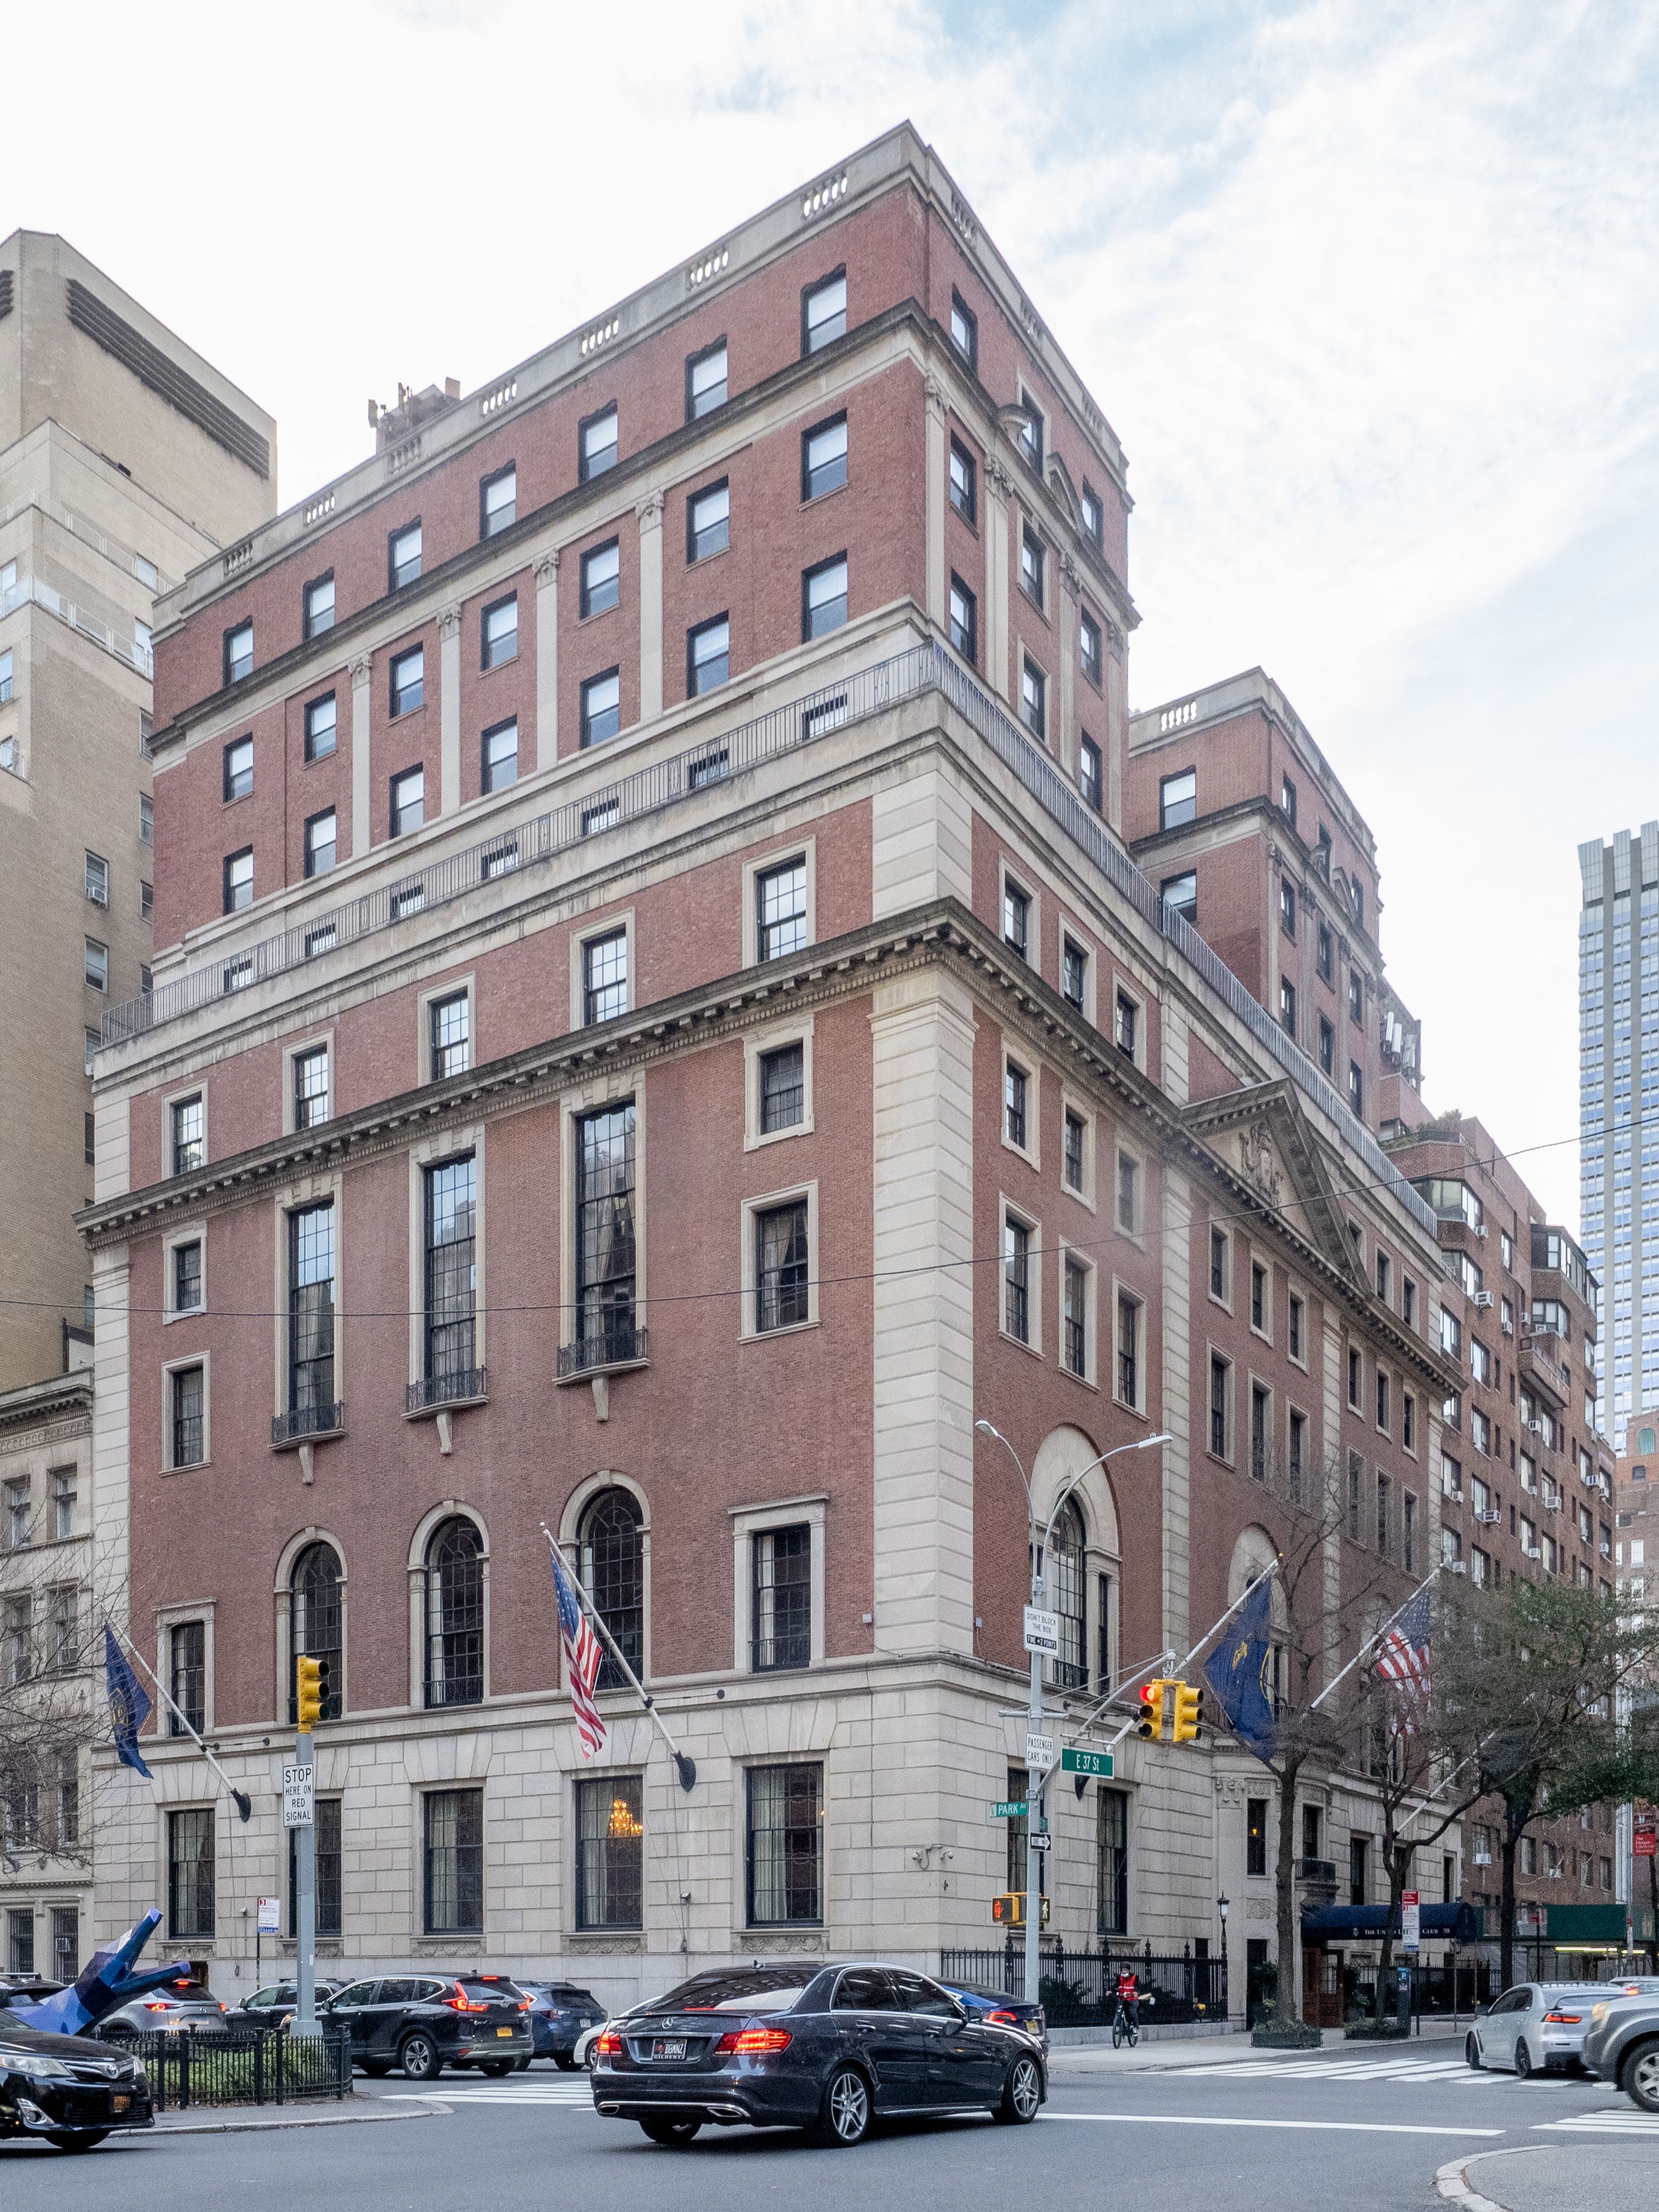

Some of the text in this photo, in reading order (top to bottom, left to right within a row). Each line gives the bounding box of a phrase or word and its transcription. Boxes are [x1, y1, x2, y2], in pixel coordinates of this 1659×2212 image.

[1042, 1616, 1057, 1626] BLOCK
[1033, 1623, 1051, 1634] THE BOX
[1043, 1639, 1056, 1650] POINTS
[1028, 1737, 1052, 1751] PASSENGER
[1028, 1751, 1052, 1764] CARS ONLY
[1076, 1754, 1100, 1771] E 37 St
[285, 1768, 311, 1784] STOP
[285, 1785, 311, 1796] HERE ON
[292, 1798, 305, 1808] RED
[998, 1804, 1018, 1815] PARK
[286, 1810, 311, 1822] SIGNAL
